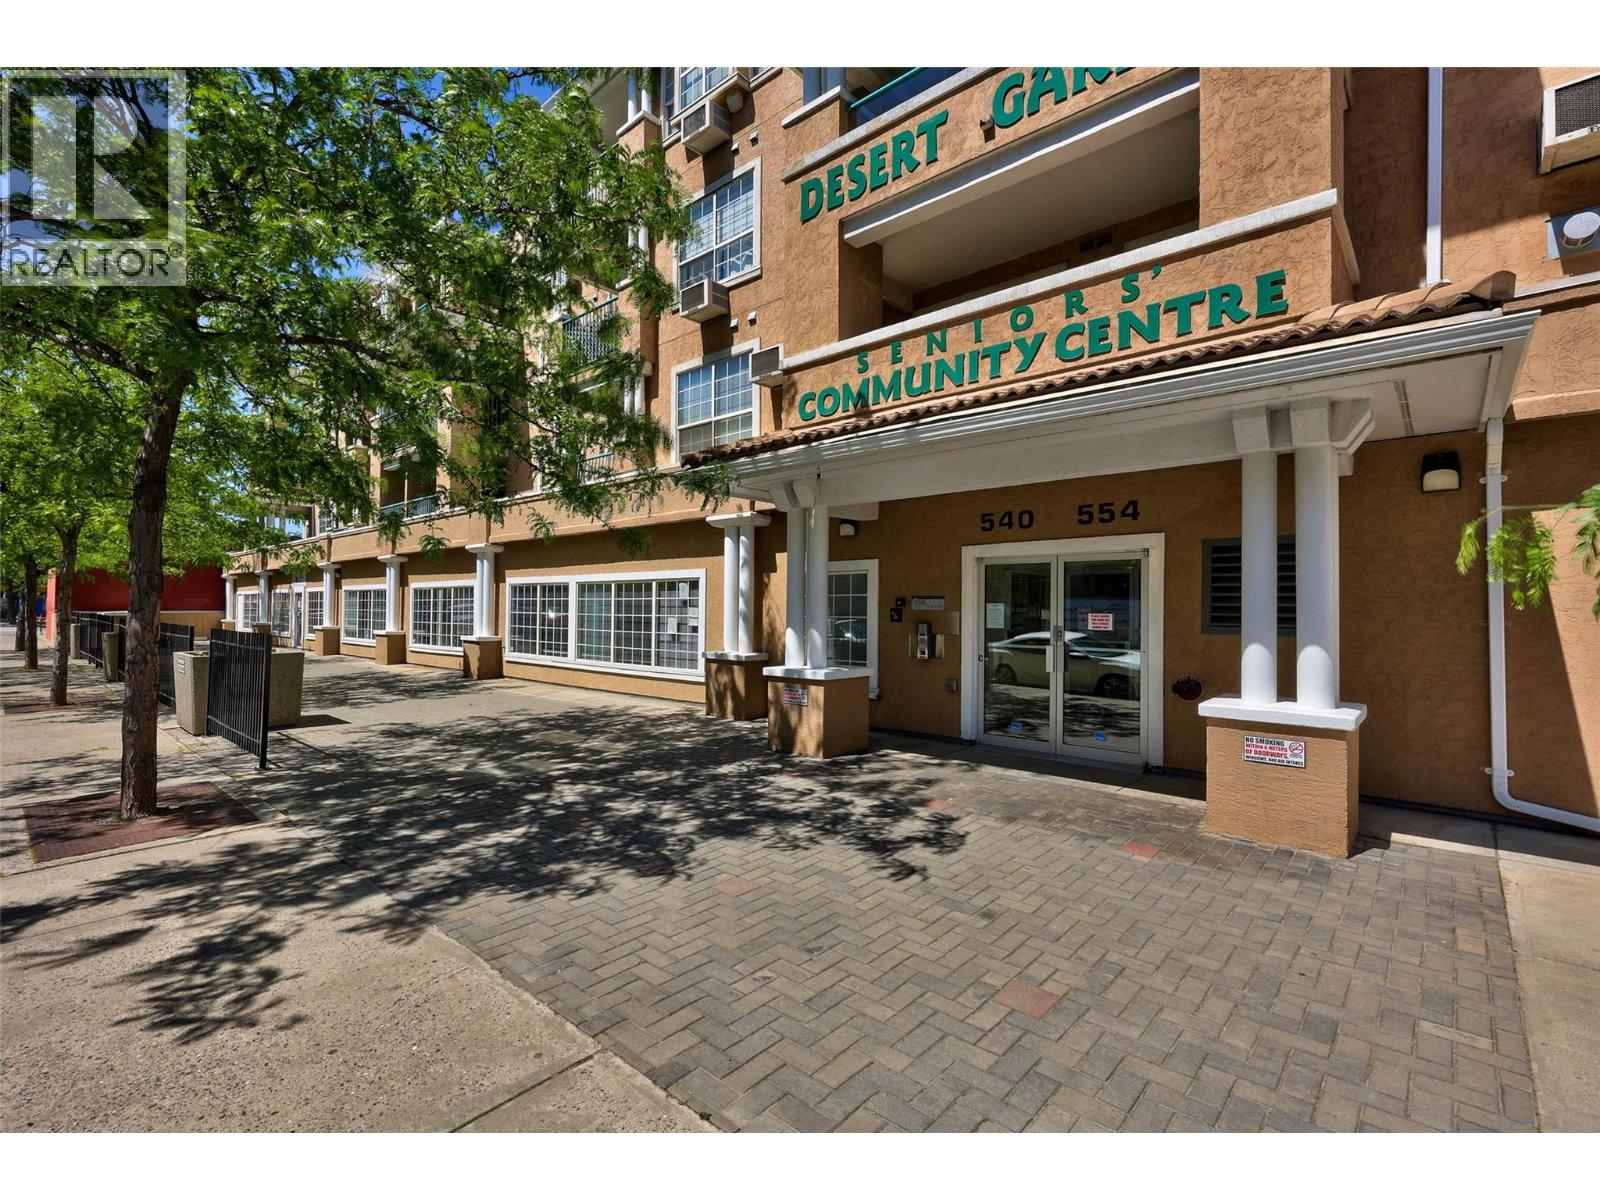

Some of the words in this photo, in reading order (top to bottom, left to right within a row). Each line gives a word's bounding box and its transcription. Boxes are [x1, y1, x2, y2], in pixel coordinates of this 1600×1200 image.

[800, 109, 949, 225] DESERT
[798, 332, 1047, 421] COMMUNITY
[1055, 269, 1289, 362] CENTRE
[980, 510, 1034, 532] 540
[1077, 500, 1140, 525] 554
[1255, 738, 1285, 747] SMOKING
